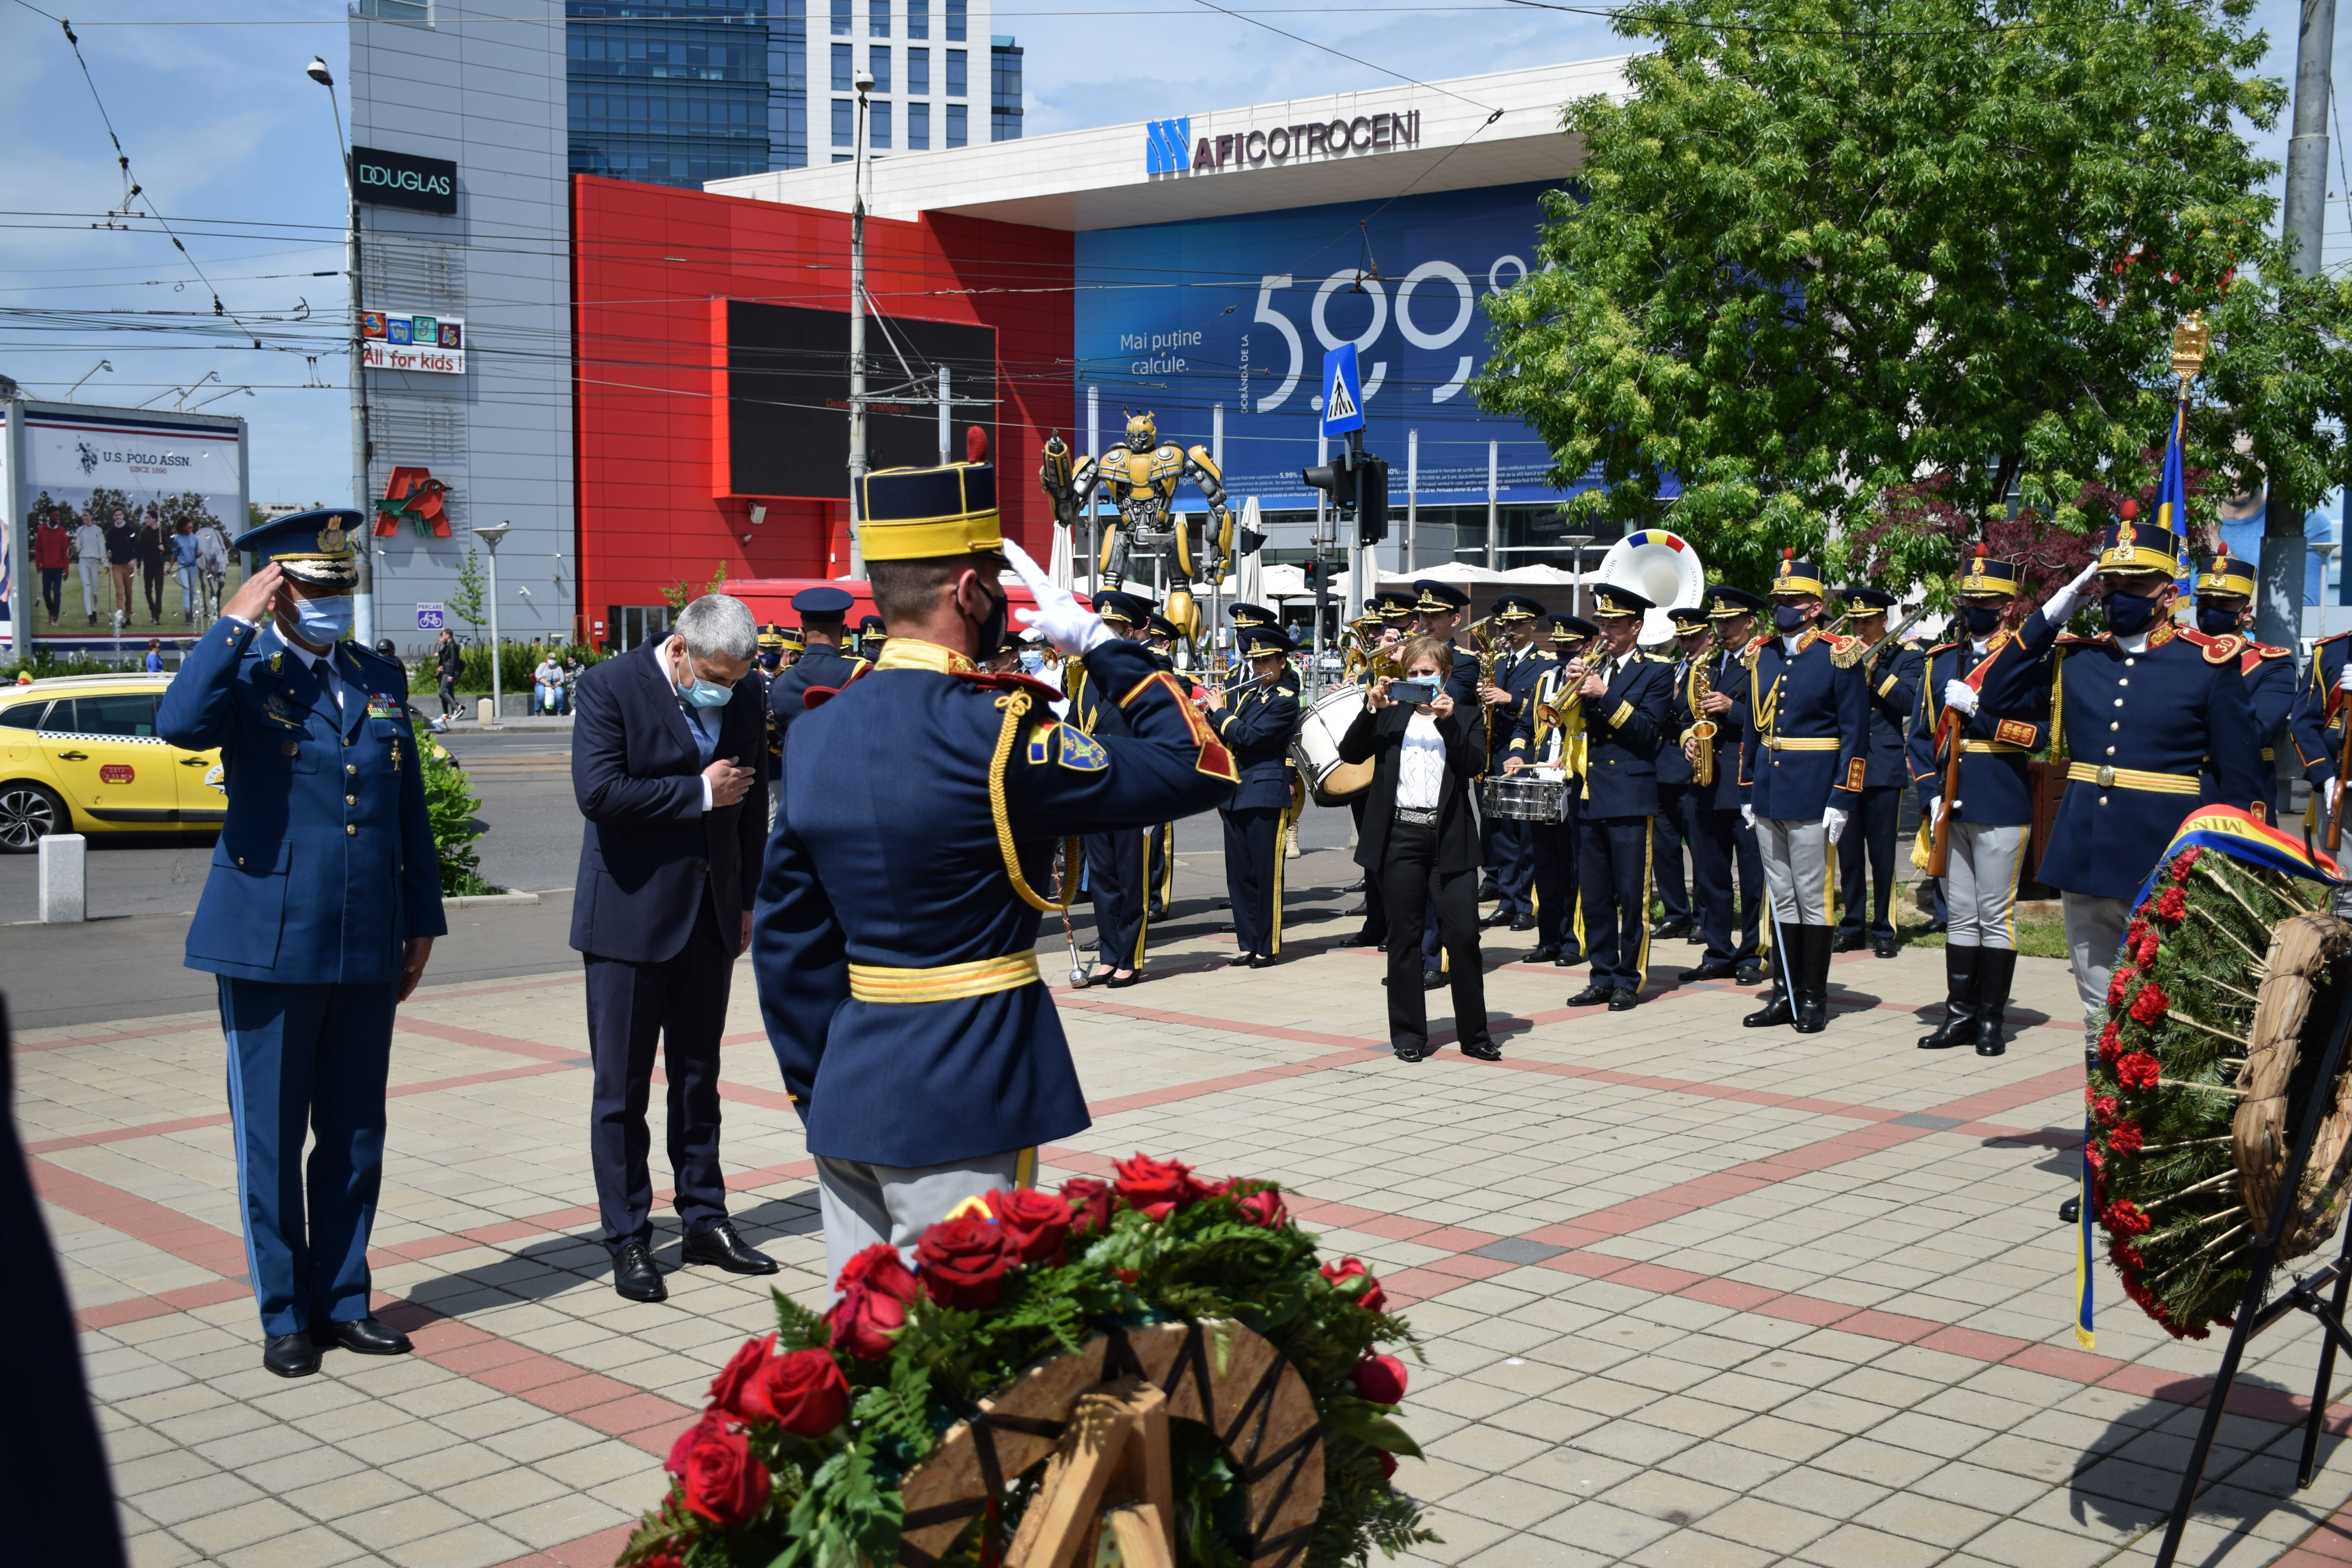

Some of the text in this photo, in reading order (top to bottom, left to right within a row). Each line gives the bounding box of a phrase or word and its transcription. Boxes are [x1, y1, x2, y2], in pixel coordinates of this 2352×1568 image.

[360, 164, 450, 195] DOUGLAS
[1121, 332, 1147, 350] Mai
[1241, 334, 1249, 346] LA
[363, 348, 383, 365] All
[390, 350, 416, 368] for
[421, 352, 454, 370] kids
[1241, 349, 1249, 361] DE
[1132, 356, 1189, 375] calcule.
[103, 452, 192, 466] U.S. POLO ASSN.
[1838, 639, 1850, 648] 30
[2215, 639, 2232, 652] 30
